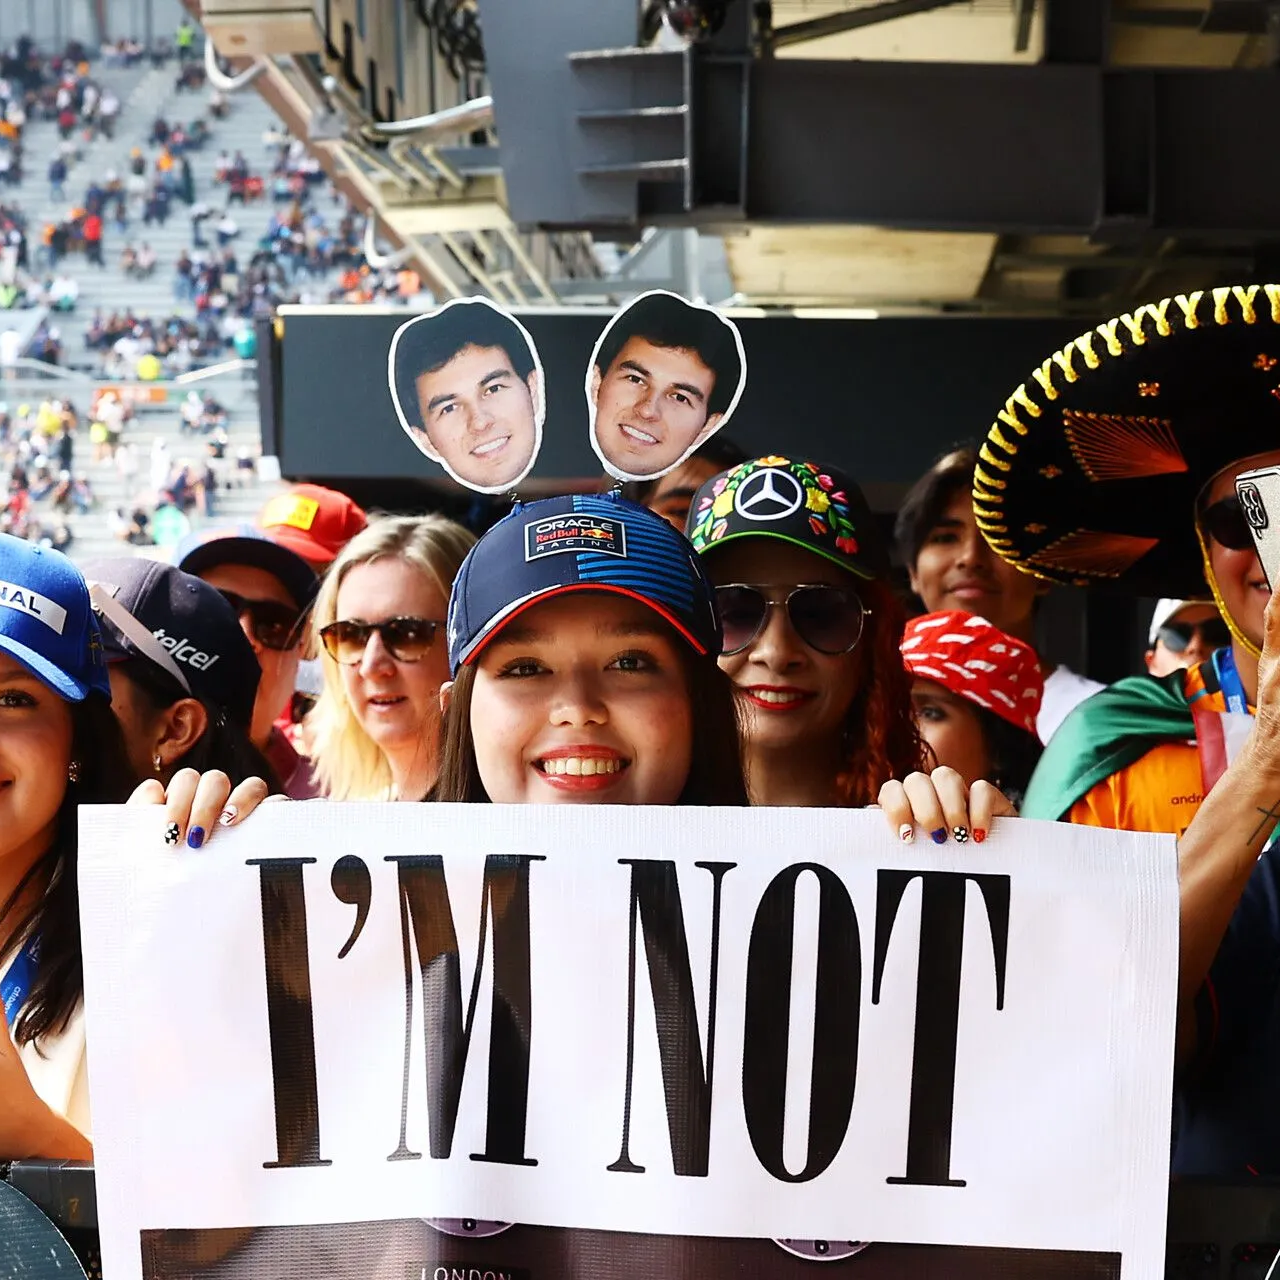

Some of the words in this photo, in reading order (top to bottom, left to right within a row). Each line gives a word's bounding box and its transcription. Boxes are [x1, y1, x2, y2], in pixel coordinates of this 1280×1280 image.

[535, 518, 614, 533] ORACLE
[536, 539, 616, 552] RACING
[152, 628, 220, 671] telcel
[245, 853, 547, 1169] I'M
[606, 858, 1012, 1188] NOT
